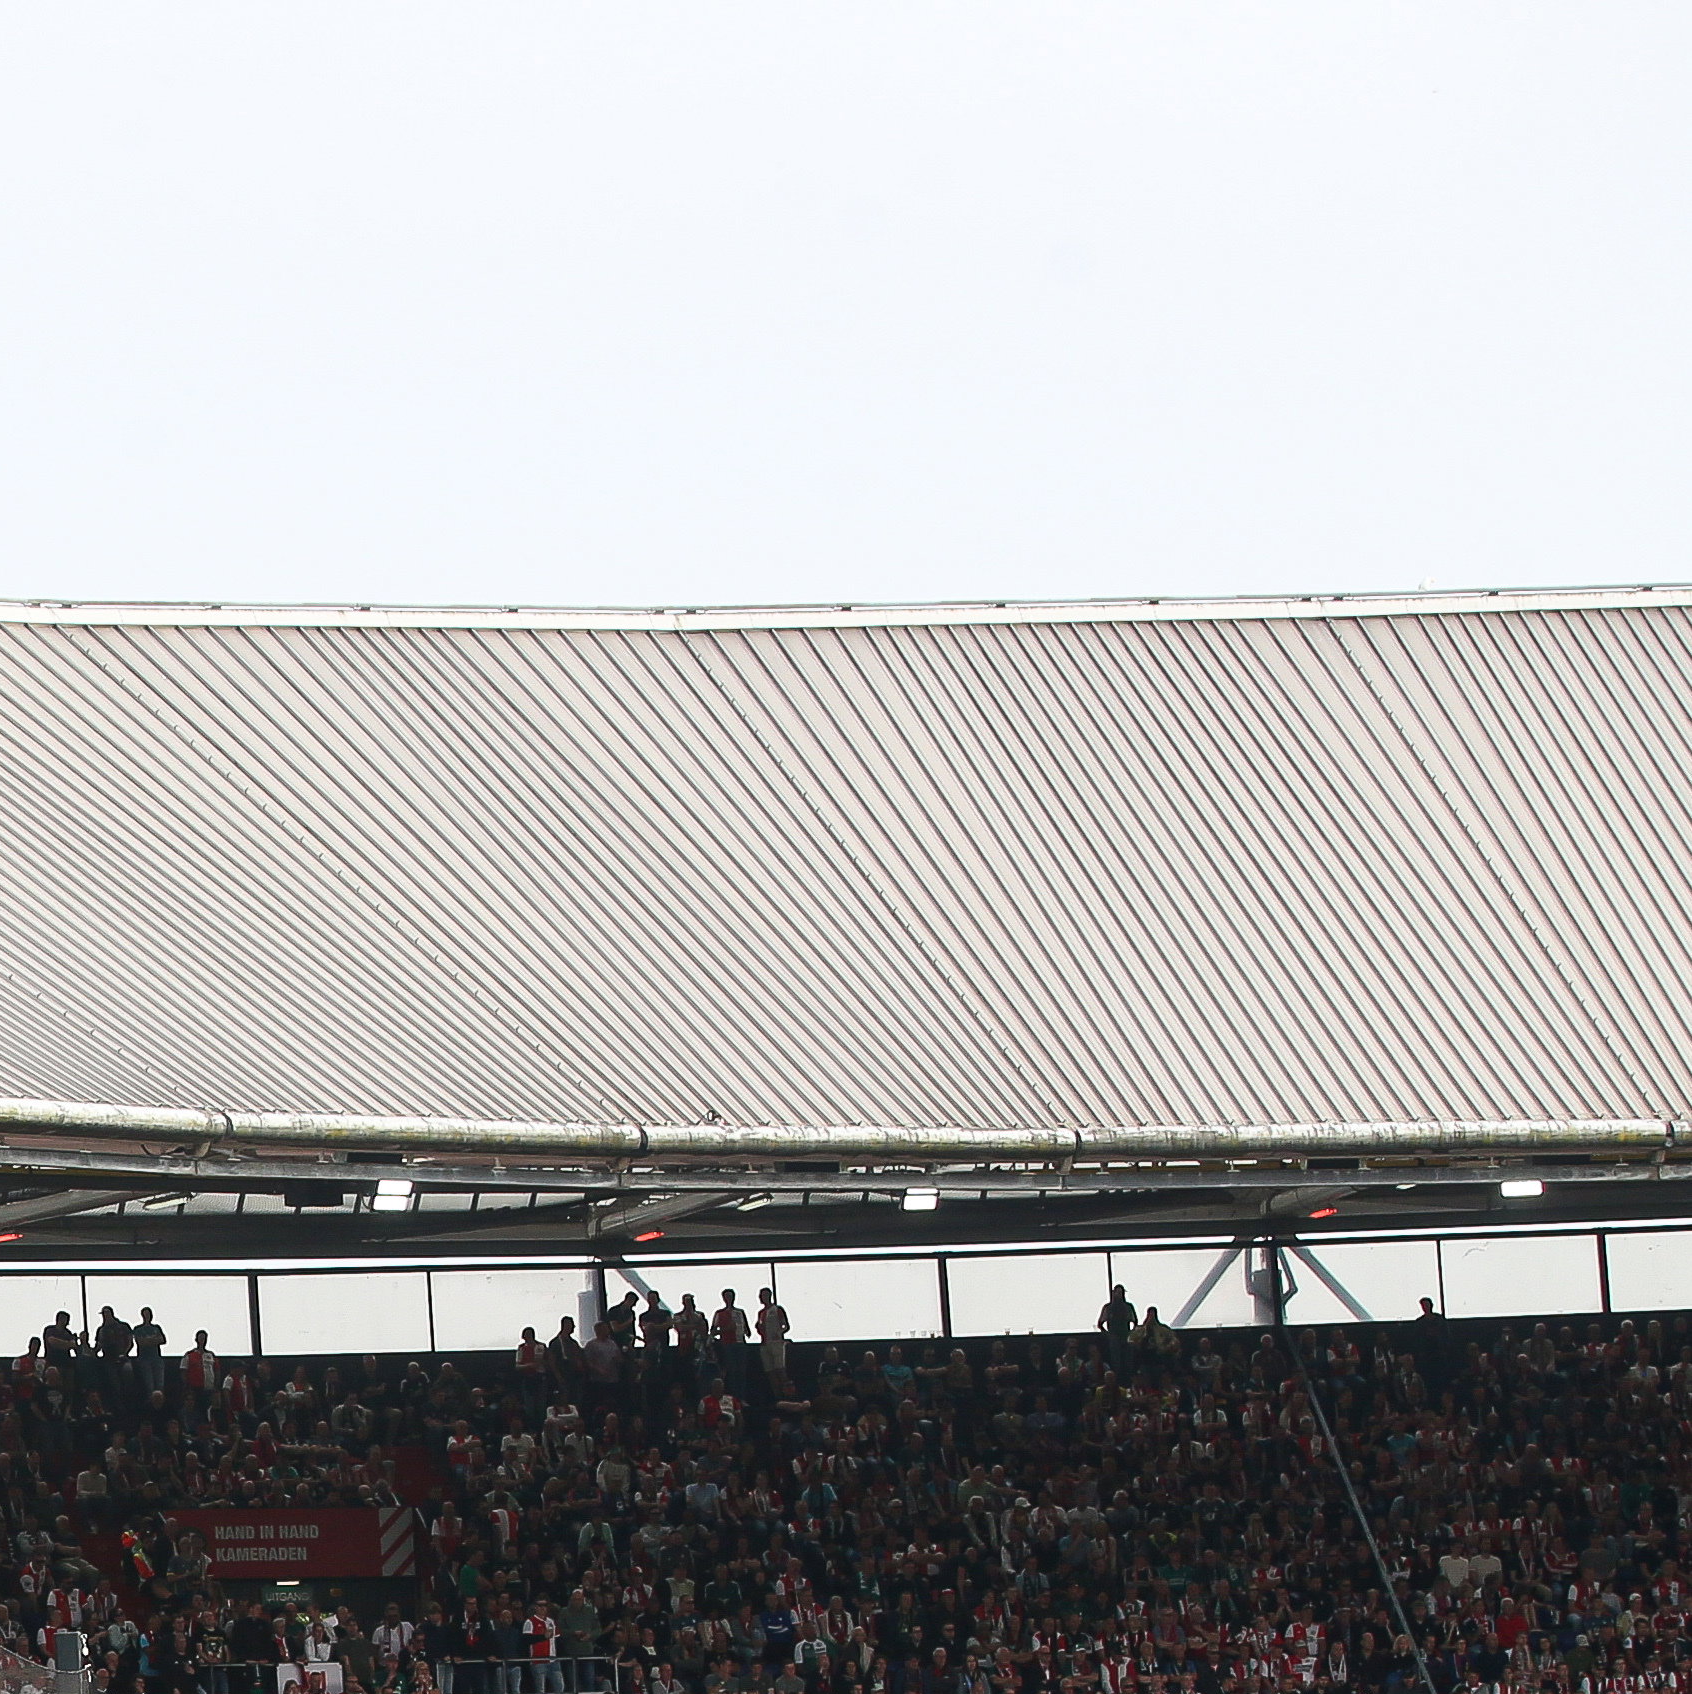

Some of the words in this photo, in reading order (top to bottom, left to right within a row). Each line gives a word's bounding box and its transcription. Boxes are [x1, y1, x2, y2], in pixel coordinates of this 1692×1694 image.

[215, 1525, 255, 1540] HAND
[259, 1525, 275, 1540] IN
[278, 1524, 320, 1540] HAND
[215, 1547, 308, 1562] KAMERADEN
